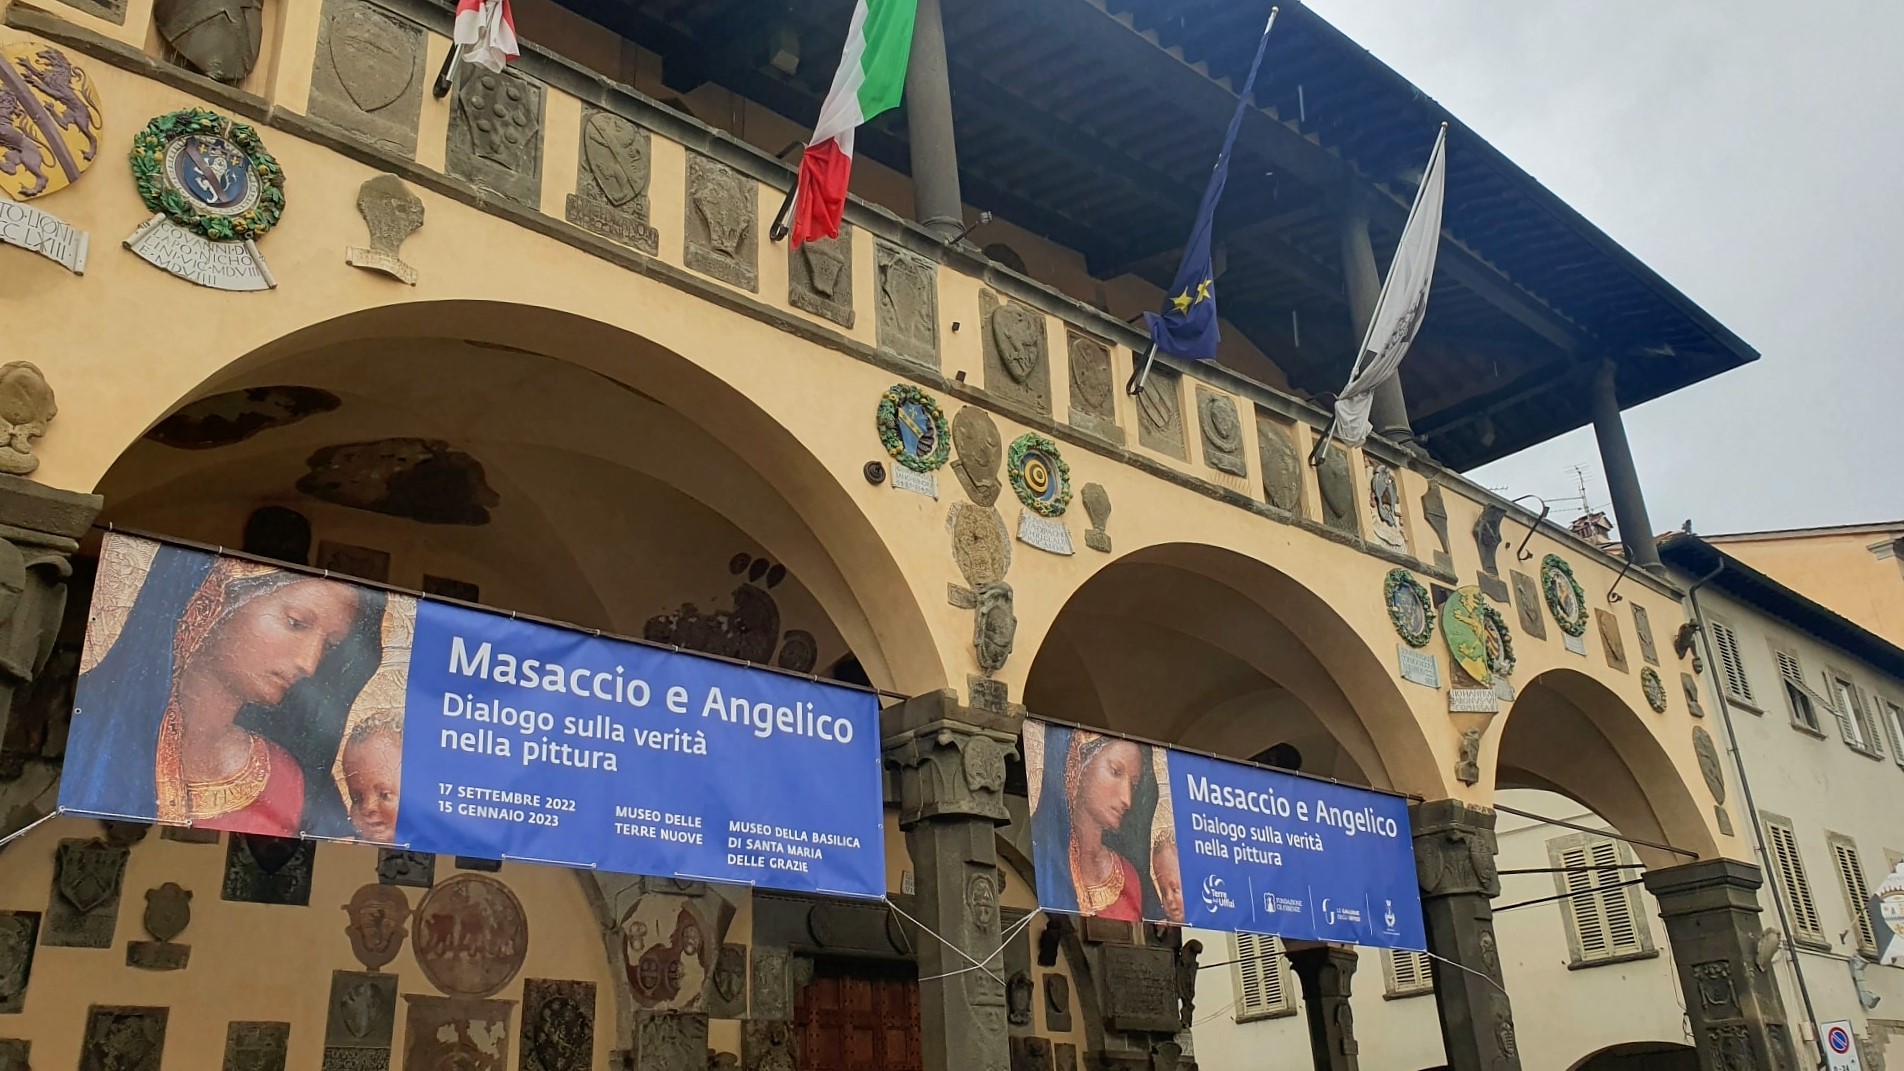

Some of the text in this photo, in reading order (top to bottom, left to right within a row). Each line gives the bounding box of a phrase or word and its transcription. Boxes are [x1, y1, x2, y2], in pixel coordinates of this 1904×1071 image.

[449, 636, 853, 744] Masaccio e Angelico
[443, 692, 707, 755] Dialogo sulla verità
[441, 728, 618, 772] nella pittura
[438, 782, 576, 812] 17 SETTEMBRE 2022
[1186, 773, 1397, 838] Masaccio e Angelico
[438, 800, 559, 827] 15 GENNAIO 2023
[615, 805, 702, 828] MUSEO DELLE
[614, 822, 703, 845] TERRE NUOVE
[729, 820, 861, 848] MUSEO DELLA BASILICA
[1191, 813, 1324, 852] Dialogo sulla verità
[728, 837, 823, 860] DI SANTA MARIA
[1194, 838, 1283, 866] nella pittura
[727, 853, 809, 873] DELLE GRAZIE
